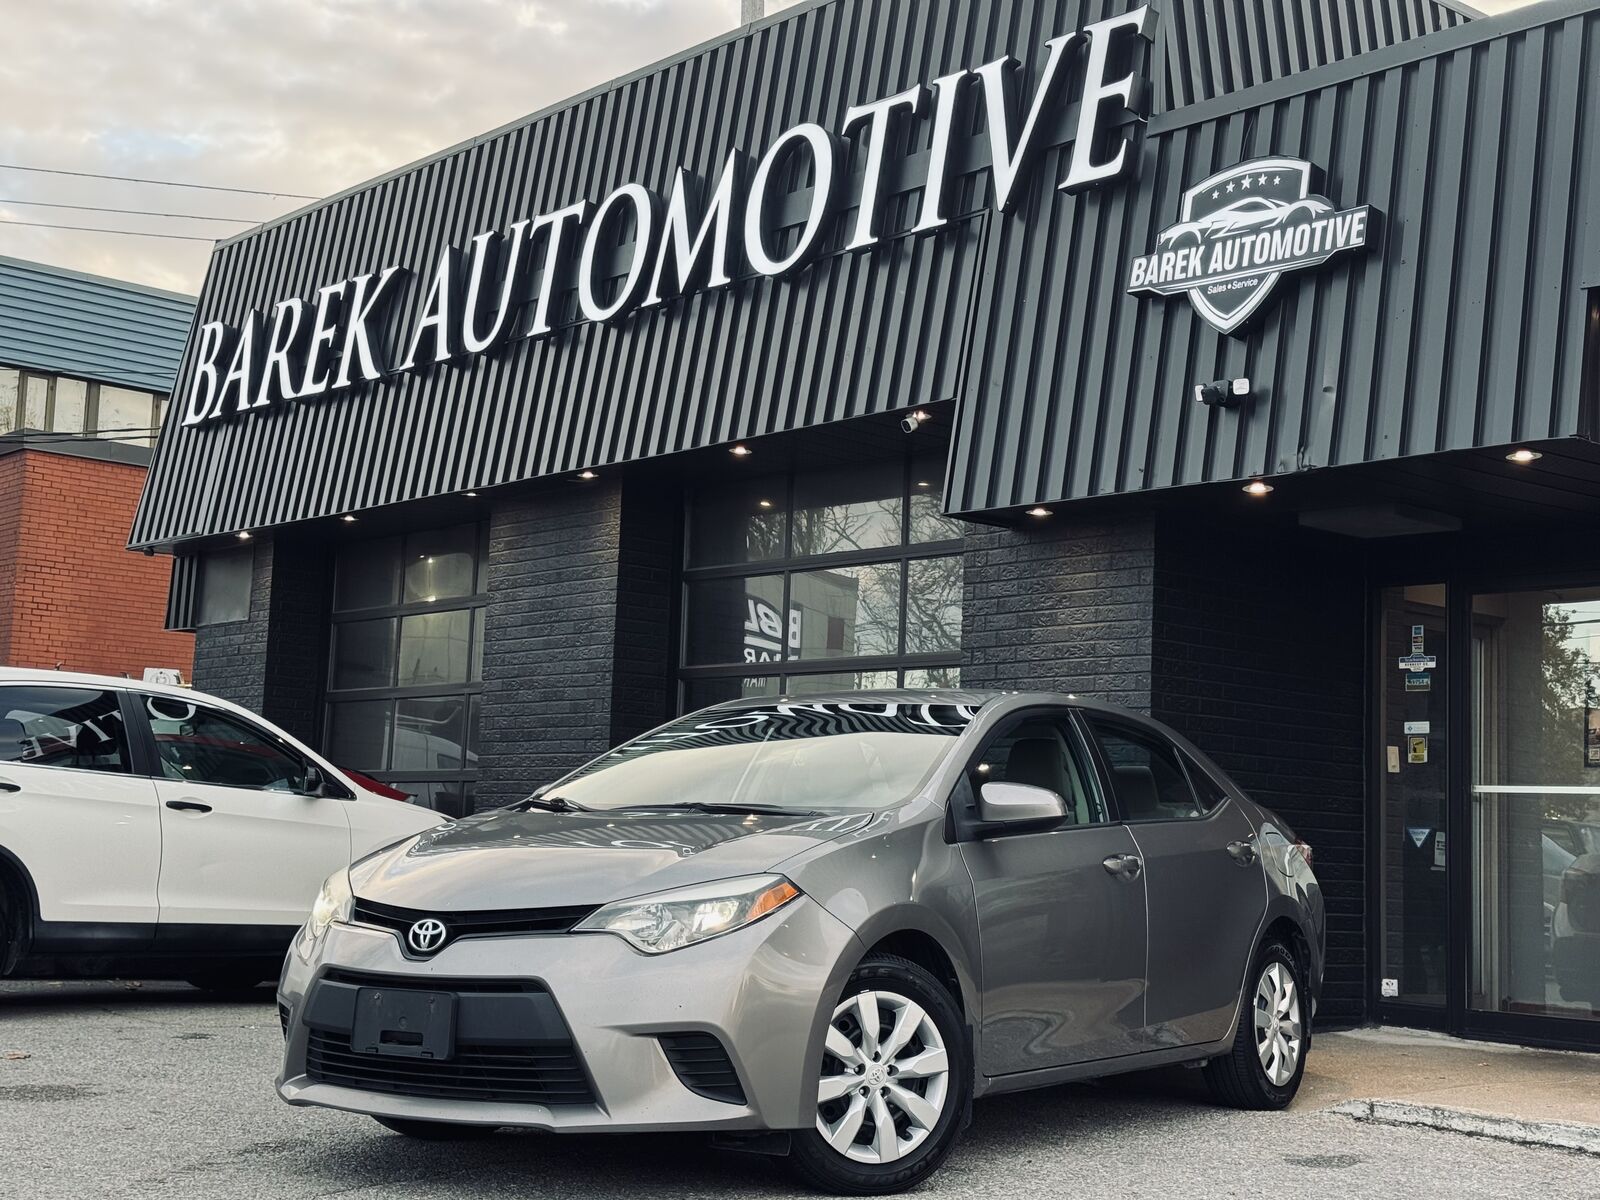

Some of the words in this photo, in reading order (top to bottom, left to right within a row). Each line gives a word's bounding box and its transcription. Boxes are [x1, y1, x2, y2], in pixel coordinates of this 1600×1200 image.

[182, 265, 400, 428] BAREK
[400, 5, 1150, 372] AUTOMOTIVE
[1130, 245, 1205, 287] BAREK
[1208, 211, 1367, 275] AUTOMOTIVE
[1207, 283, 1227, 295] Sales
[1232, 278, 1259, 291] Service
